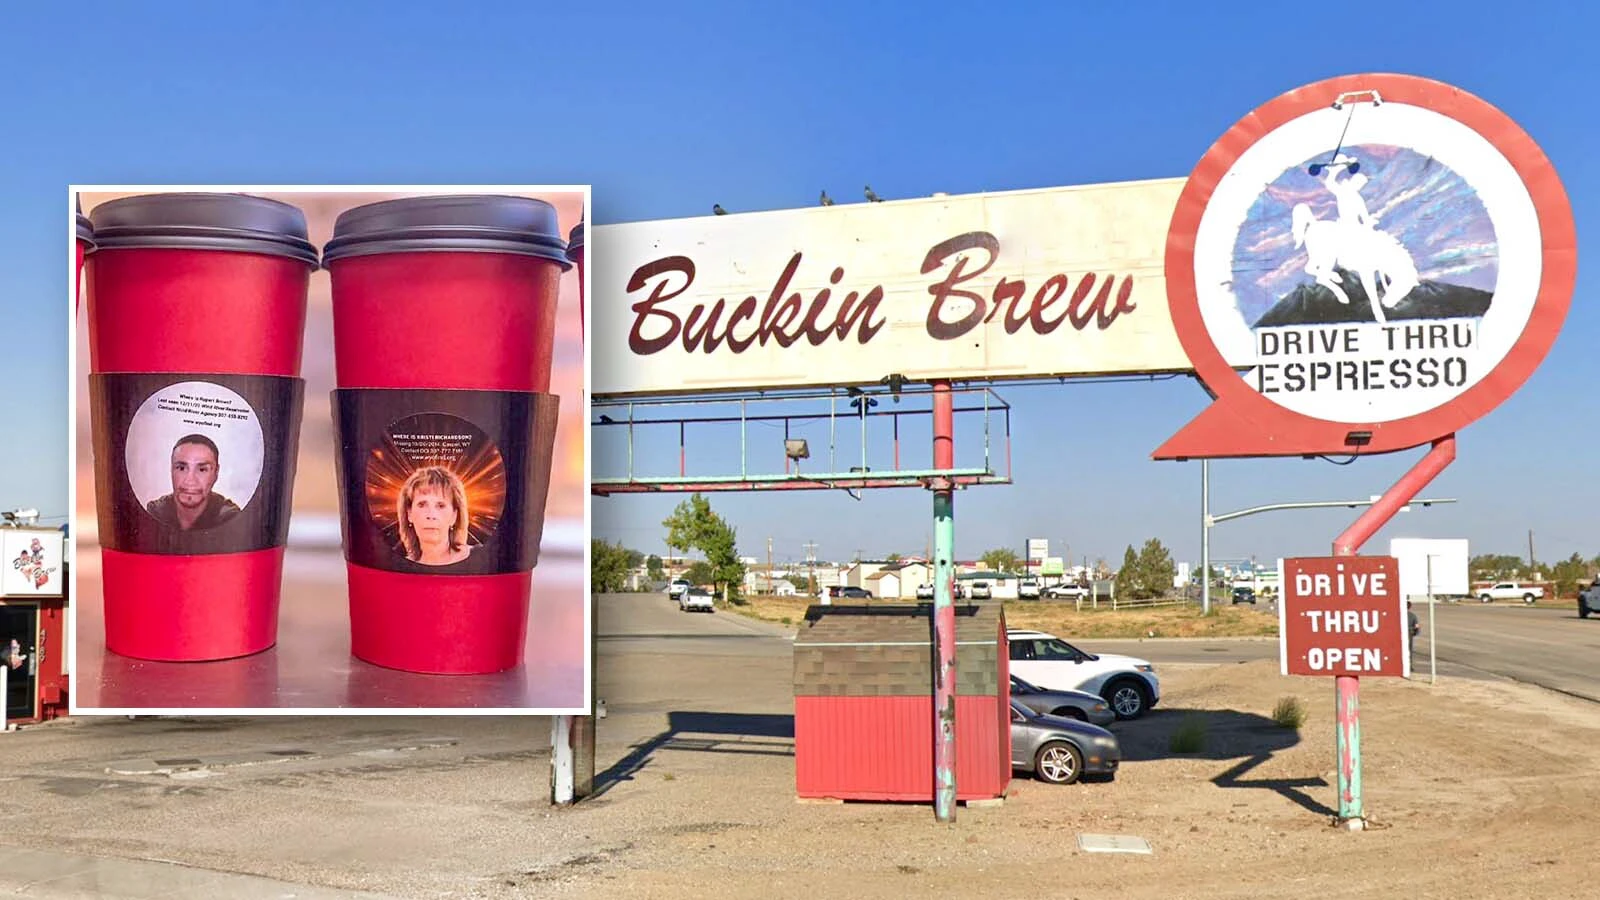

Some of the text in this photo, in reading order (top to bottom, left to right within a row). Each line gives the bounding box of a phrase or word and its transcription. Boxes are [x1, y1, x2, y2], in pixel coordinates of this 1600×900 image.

[626, 230, 1138, 356] Buckin Brew
[1260, 323, 1473, 356] DRIVE THRU
[1258, 357, 1468, 394] ESPRESSO
[1306, 609, 1380, 634] THRU
[1307, 647, 1382, 672] OPEN
